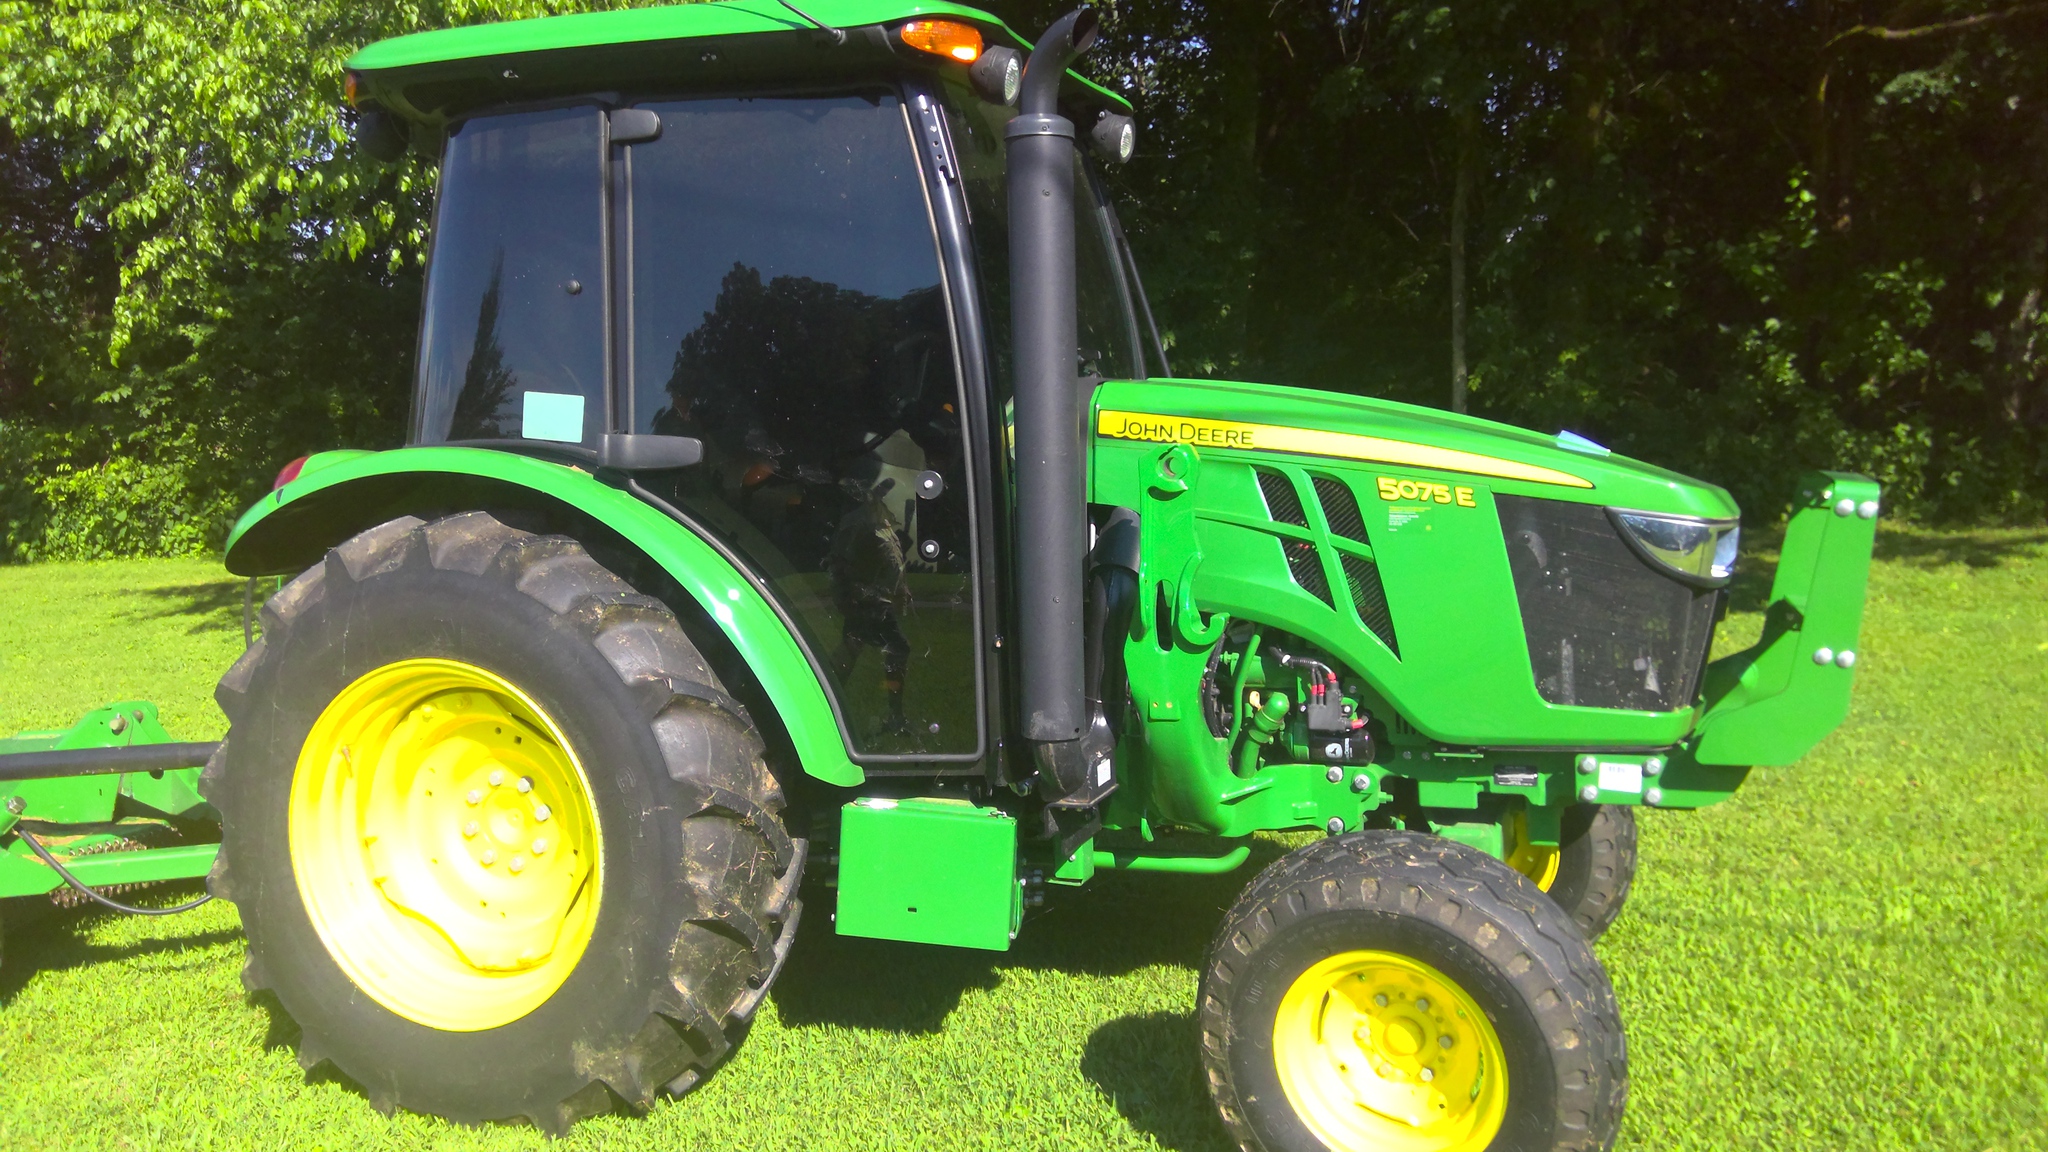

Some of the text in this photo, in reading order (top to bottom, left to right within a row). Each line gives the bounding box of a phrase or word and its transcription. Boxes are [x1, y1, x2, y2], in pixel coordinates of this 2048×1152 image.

[1116, 417, 1254, 446] JOHN DEERE
[1376, 476, 1477, 508] 5075 E
